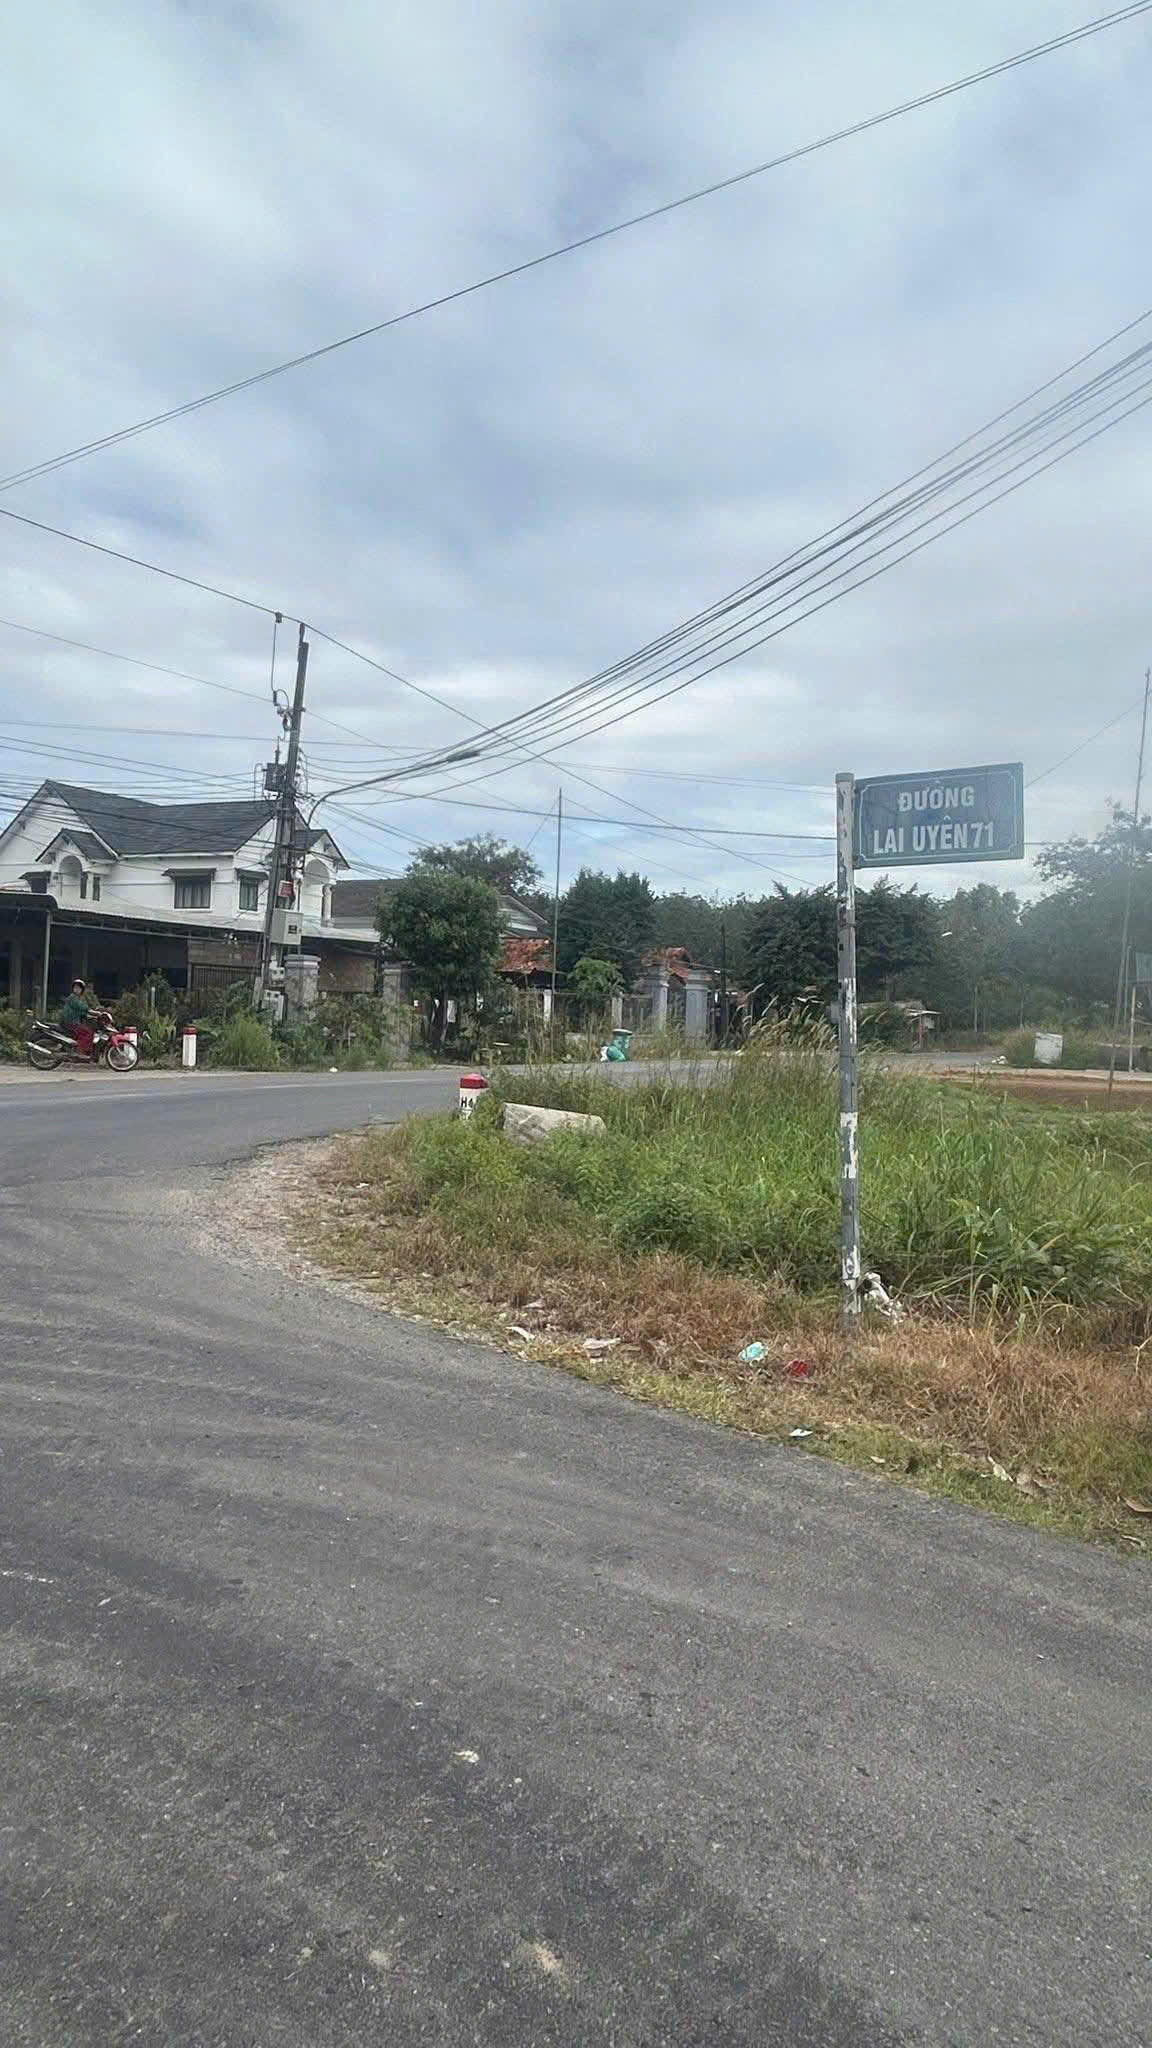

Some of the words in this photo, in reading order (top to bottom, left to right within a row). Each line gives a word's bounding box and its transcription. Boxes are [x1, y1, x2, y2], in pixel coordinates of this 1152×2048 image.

[898, 780, 976, 812] ĐƯỜNG
[873, 826, 904, 855] LAI
[912, 815, 968, 852] UYÊN
[970, 821, 994, 848] 71
